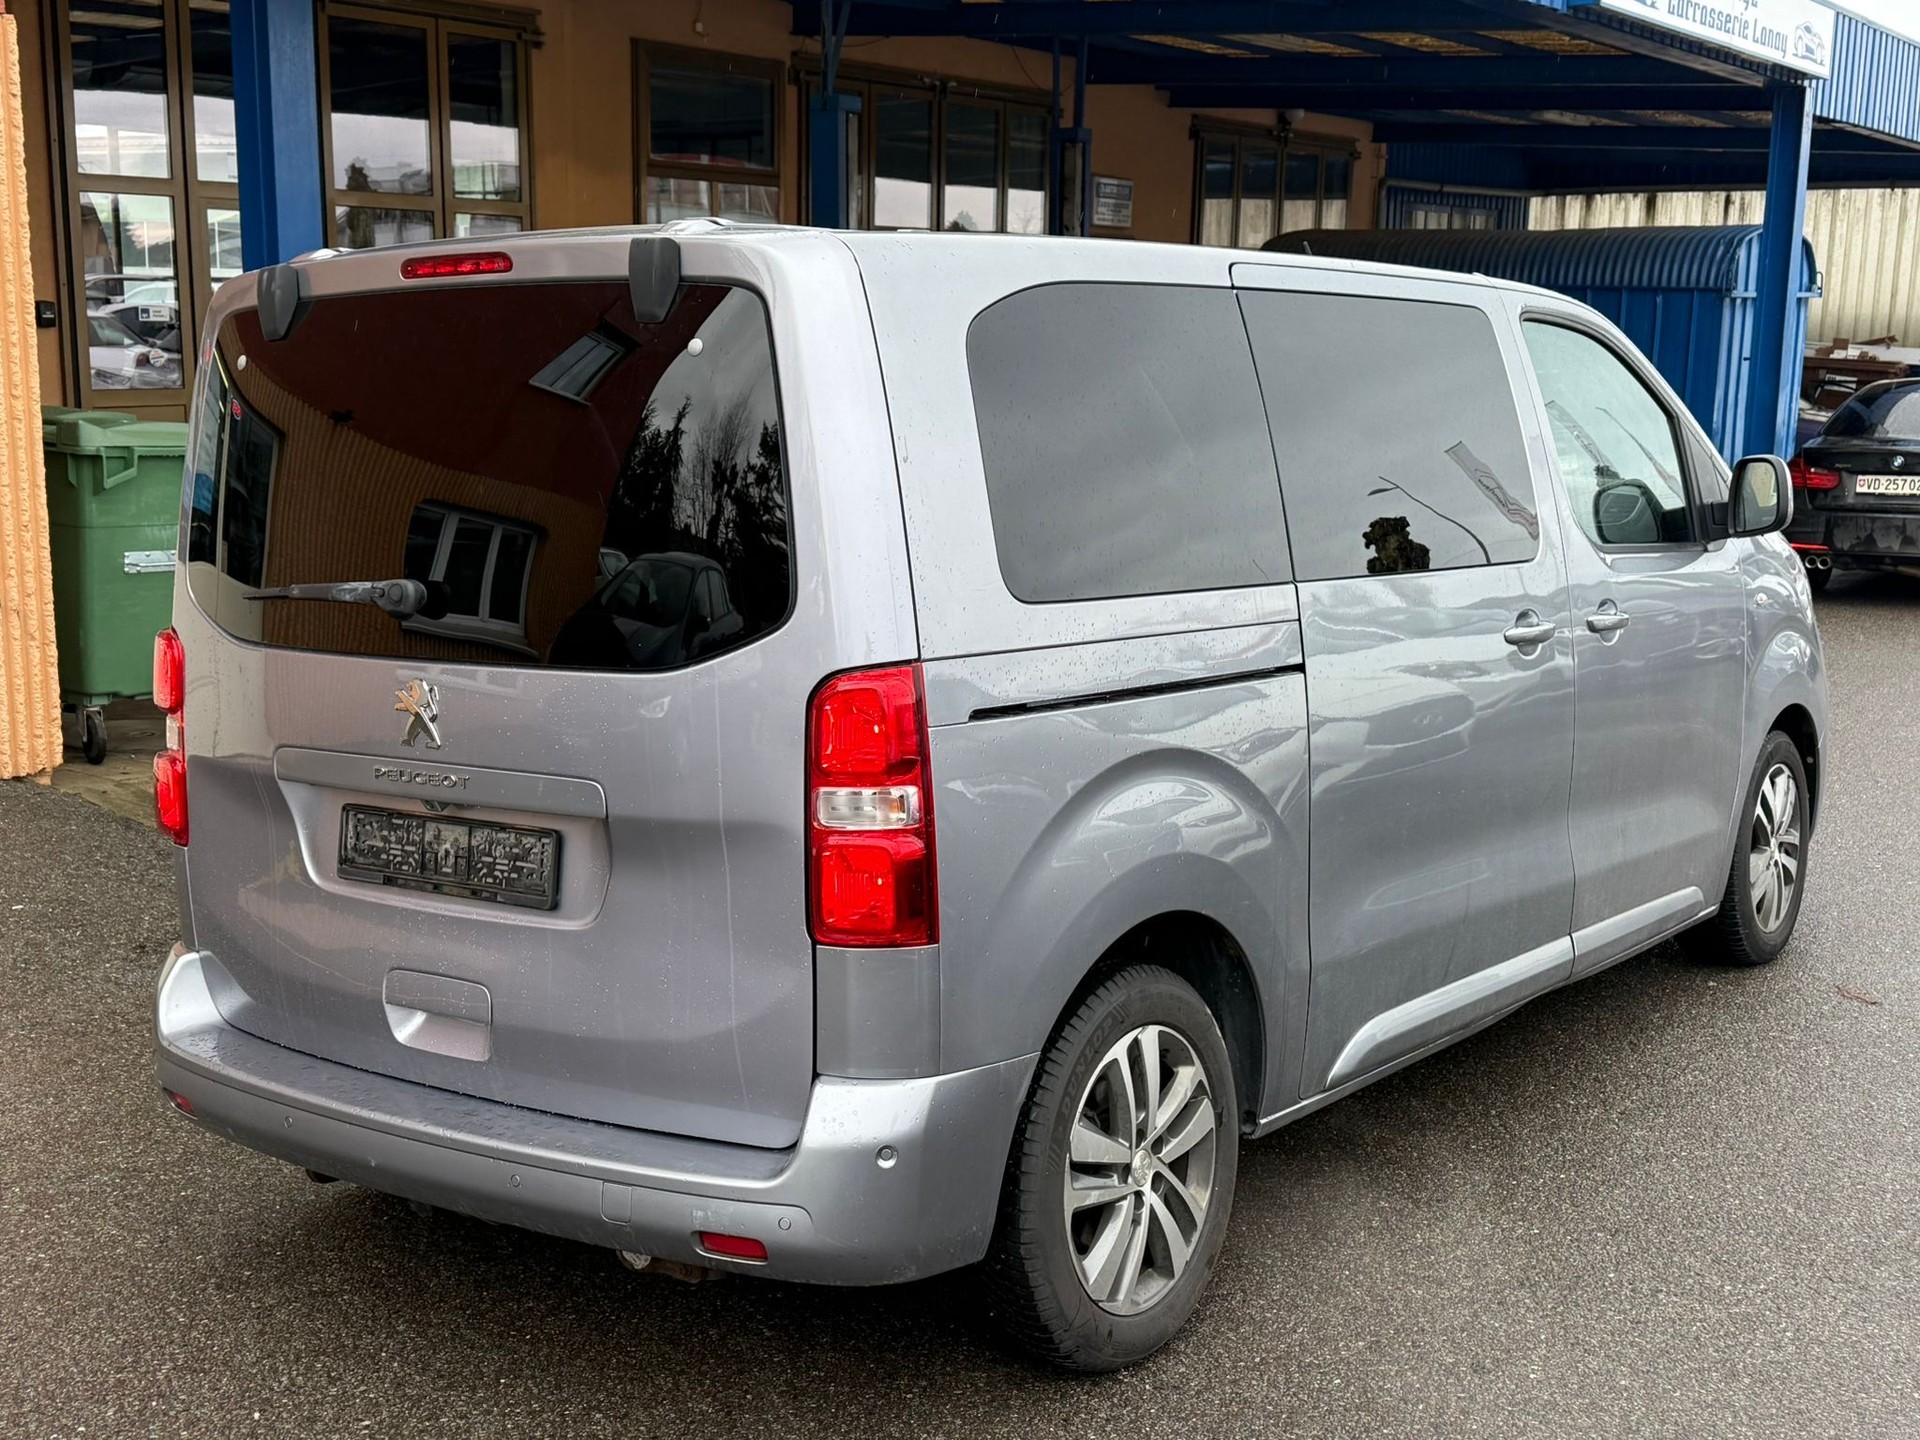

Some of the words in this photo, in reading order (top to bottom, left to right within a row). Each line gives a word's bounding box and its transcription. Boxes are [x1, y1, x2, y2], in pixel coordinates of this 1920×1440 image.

[1752, 18, 1788, 59] Lonay
[374, 766, 470, 789] PEUGEOT
[1061, 1019, 1112, 1114] DUNLOP
